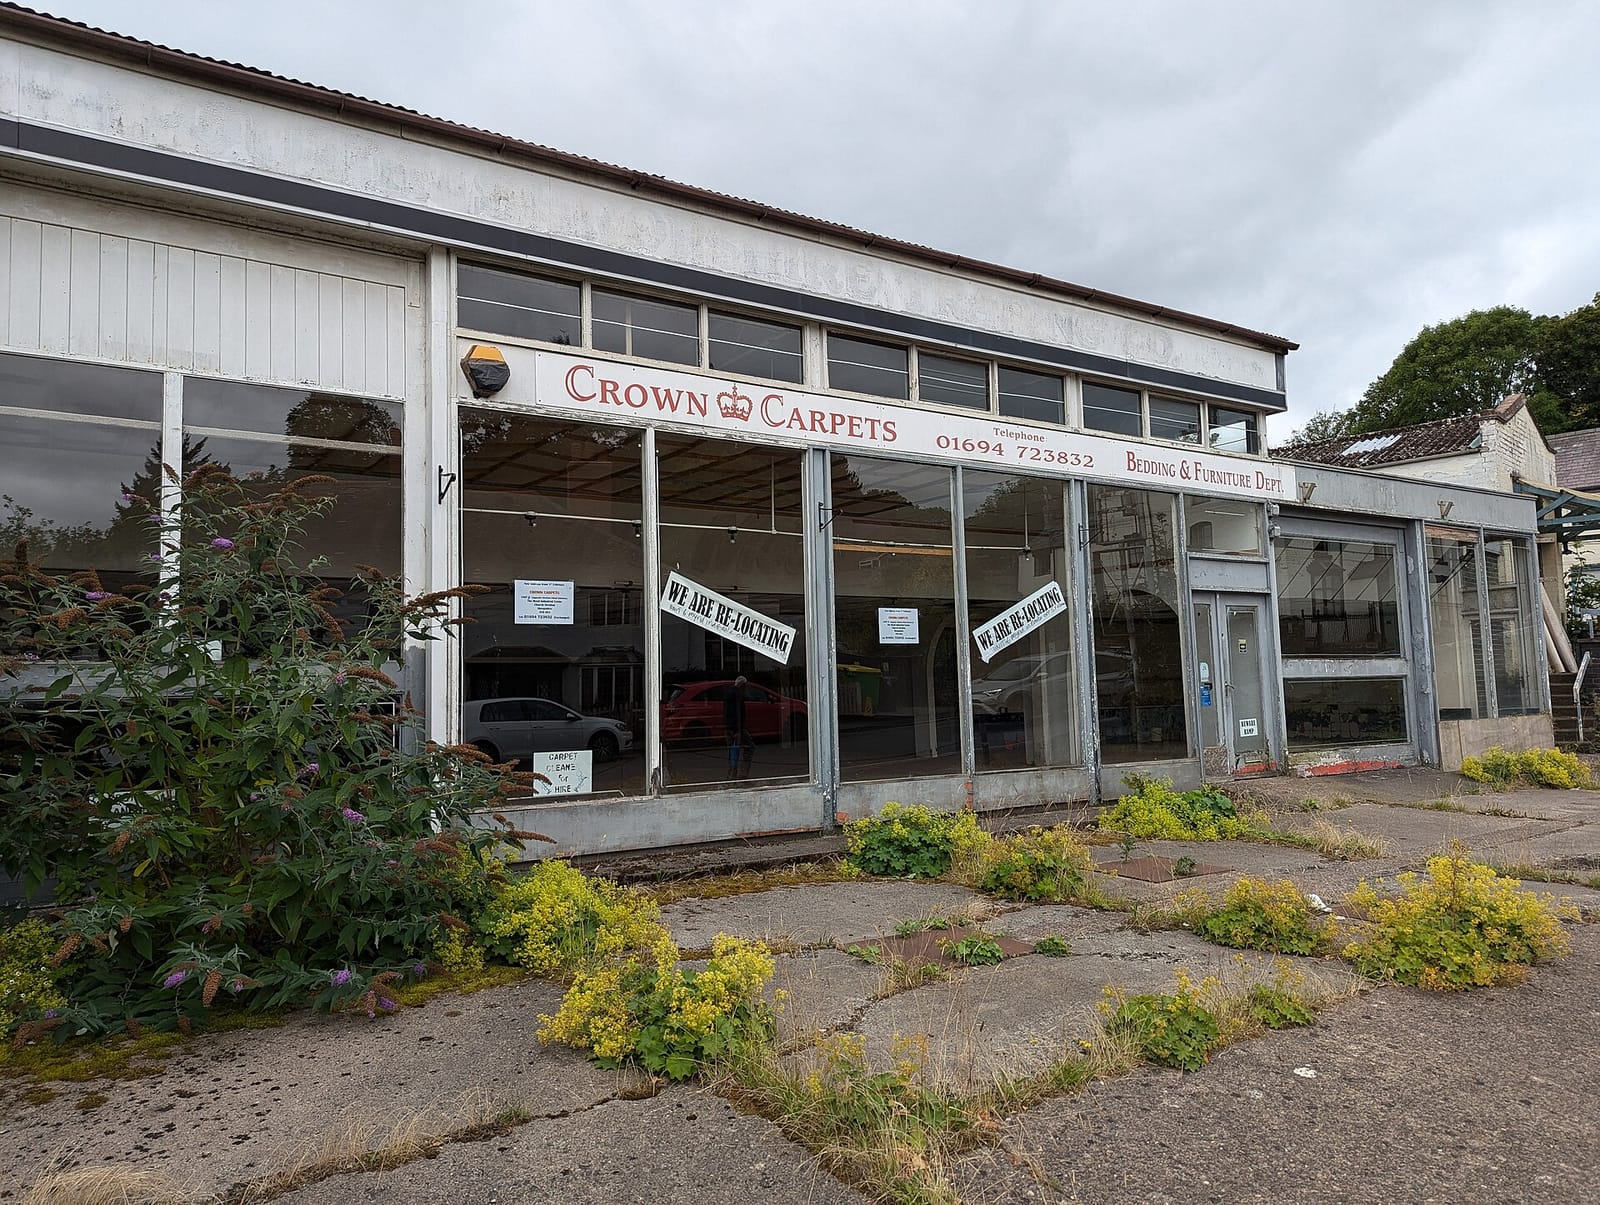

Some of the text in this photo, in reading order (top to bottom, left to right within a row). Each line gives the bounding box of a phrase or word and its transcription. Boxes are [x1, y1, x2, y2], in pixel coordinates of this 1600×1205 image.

[565, 364, 898, 442] CROWN CARPETS
[936, 435, 1095, 468] 01694 723832
[1126, 451, 1285, 493] BEDDING & FURNITURE DEPT.
[668, 580, 690, 607] WE
[688, 591, 715, 618] ARE
[714, 602, 790, 652] RE-LOCATING
[977, 629, 994, 651] WE
[992, 618, 1012, 643] ARE
[1009, 586, 1062, 631] RE-LOCATING
[548, 752, 578, 761] CARPET
[554, 784, 572, 793] HIRE
